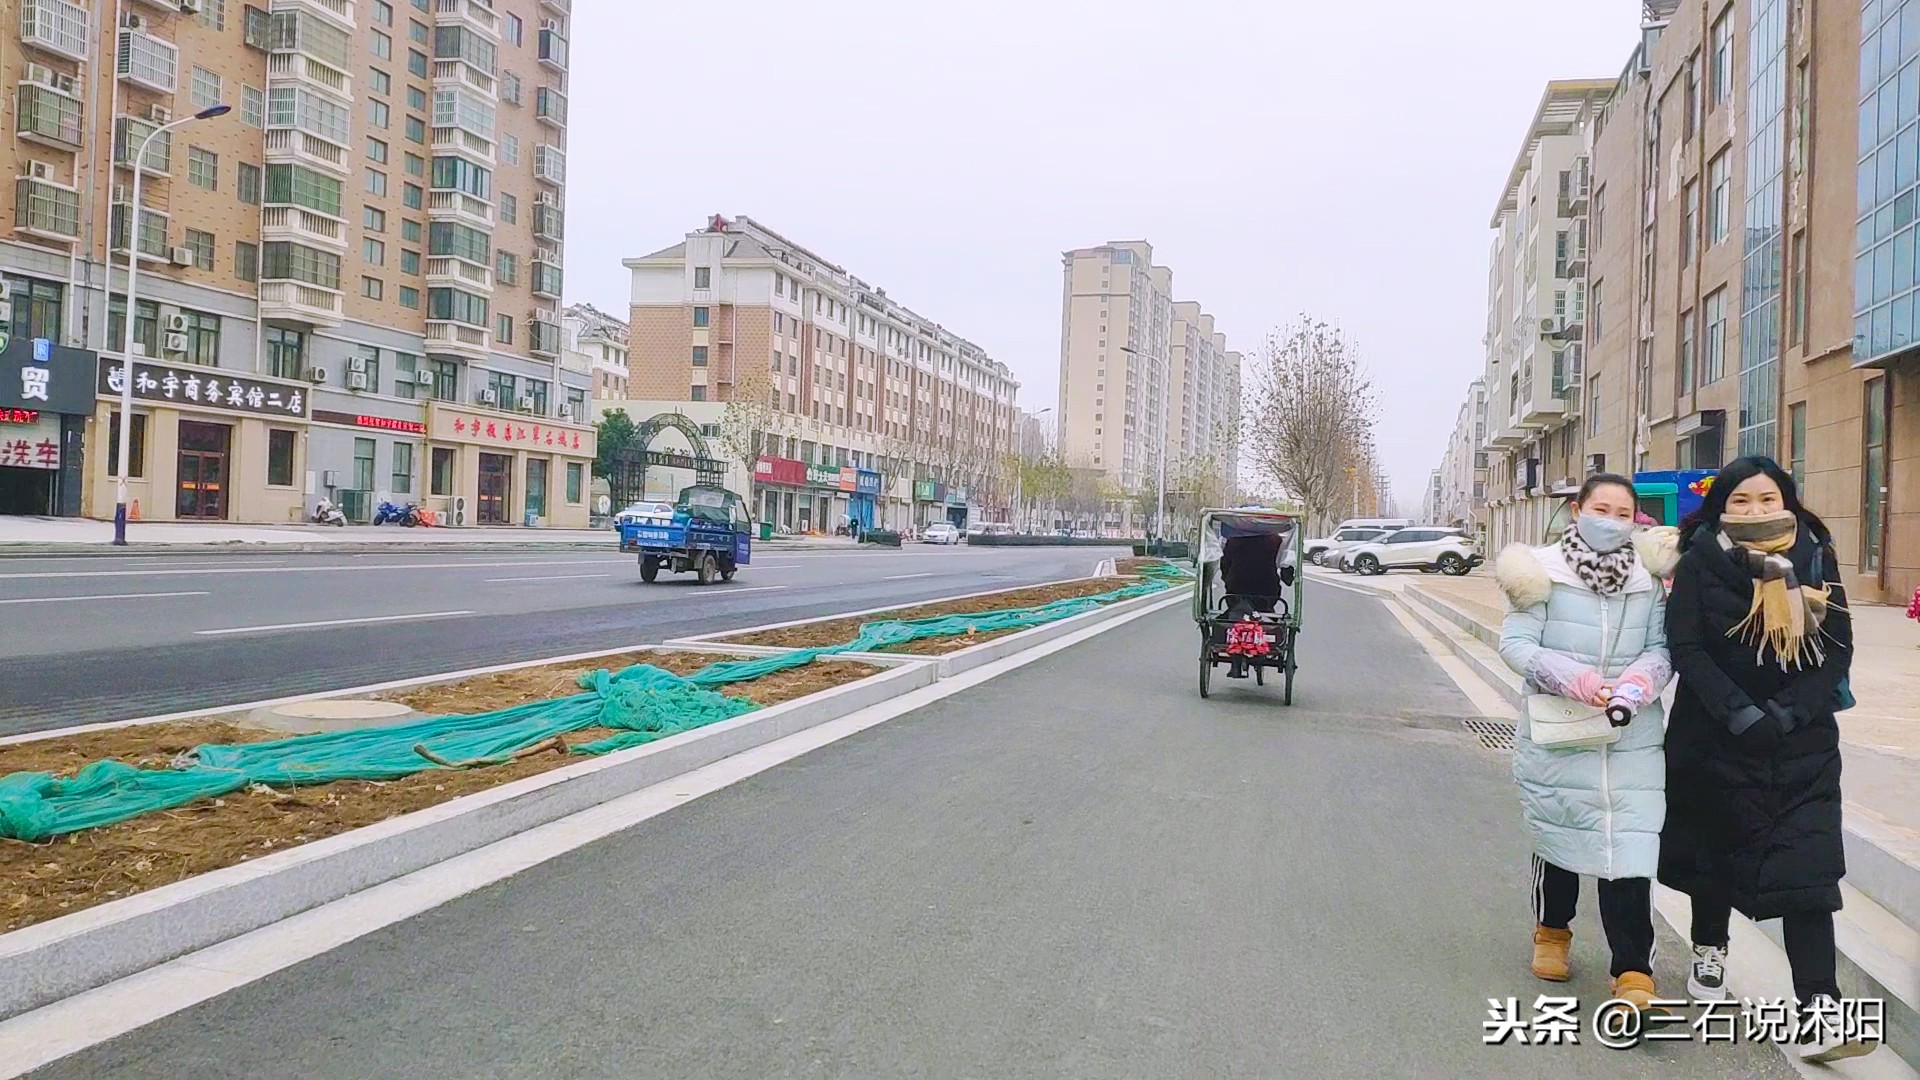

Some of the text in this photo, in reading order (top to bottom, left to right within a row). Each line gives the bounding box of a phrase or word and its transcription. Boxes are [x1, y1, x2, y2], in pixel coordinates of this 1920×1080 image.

[21, 366, 50, 401] 贸
[136, 371, 302, 414] 和宇商务宾馆二店
[1, 437, 59, 467] 洗车
